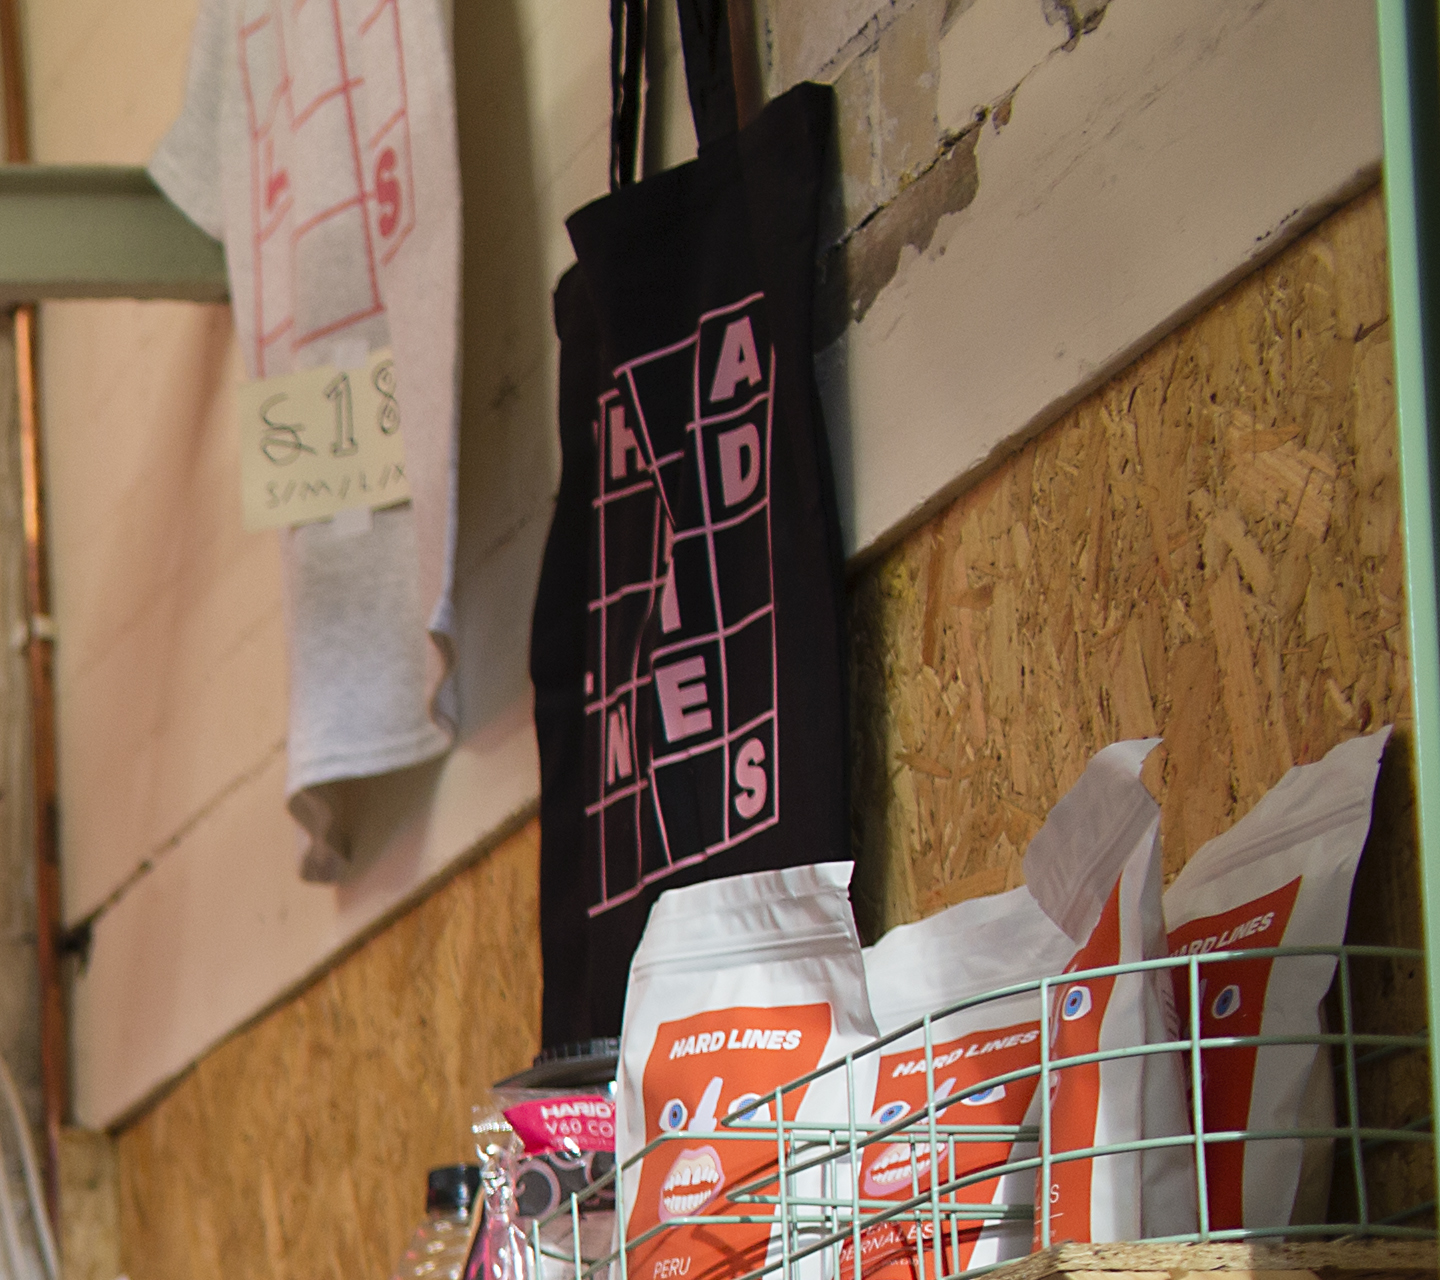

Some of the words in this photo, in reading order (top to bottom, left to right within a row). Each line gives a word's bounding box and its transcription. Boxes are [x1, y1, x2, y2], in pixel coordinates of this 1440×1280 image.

[1221, 912, 1274, 949] LINES
[669, 1032, 726, 1060] HARD
[727, 1028, 803, 1051] LINES
[966, 1029, 1040, 1058] LINES
[545, 1120, 581, 1135] V60
[653, 1257, 691, 1280] PERU
